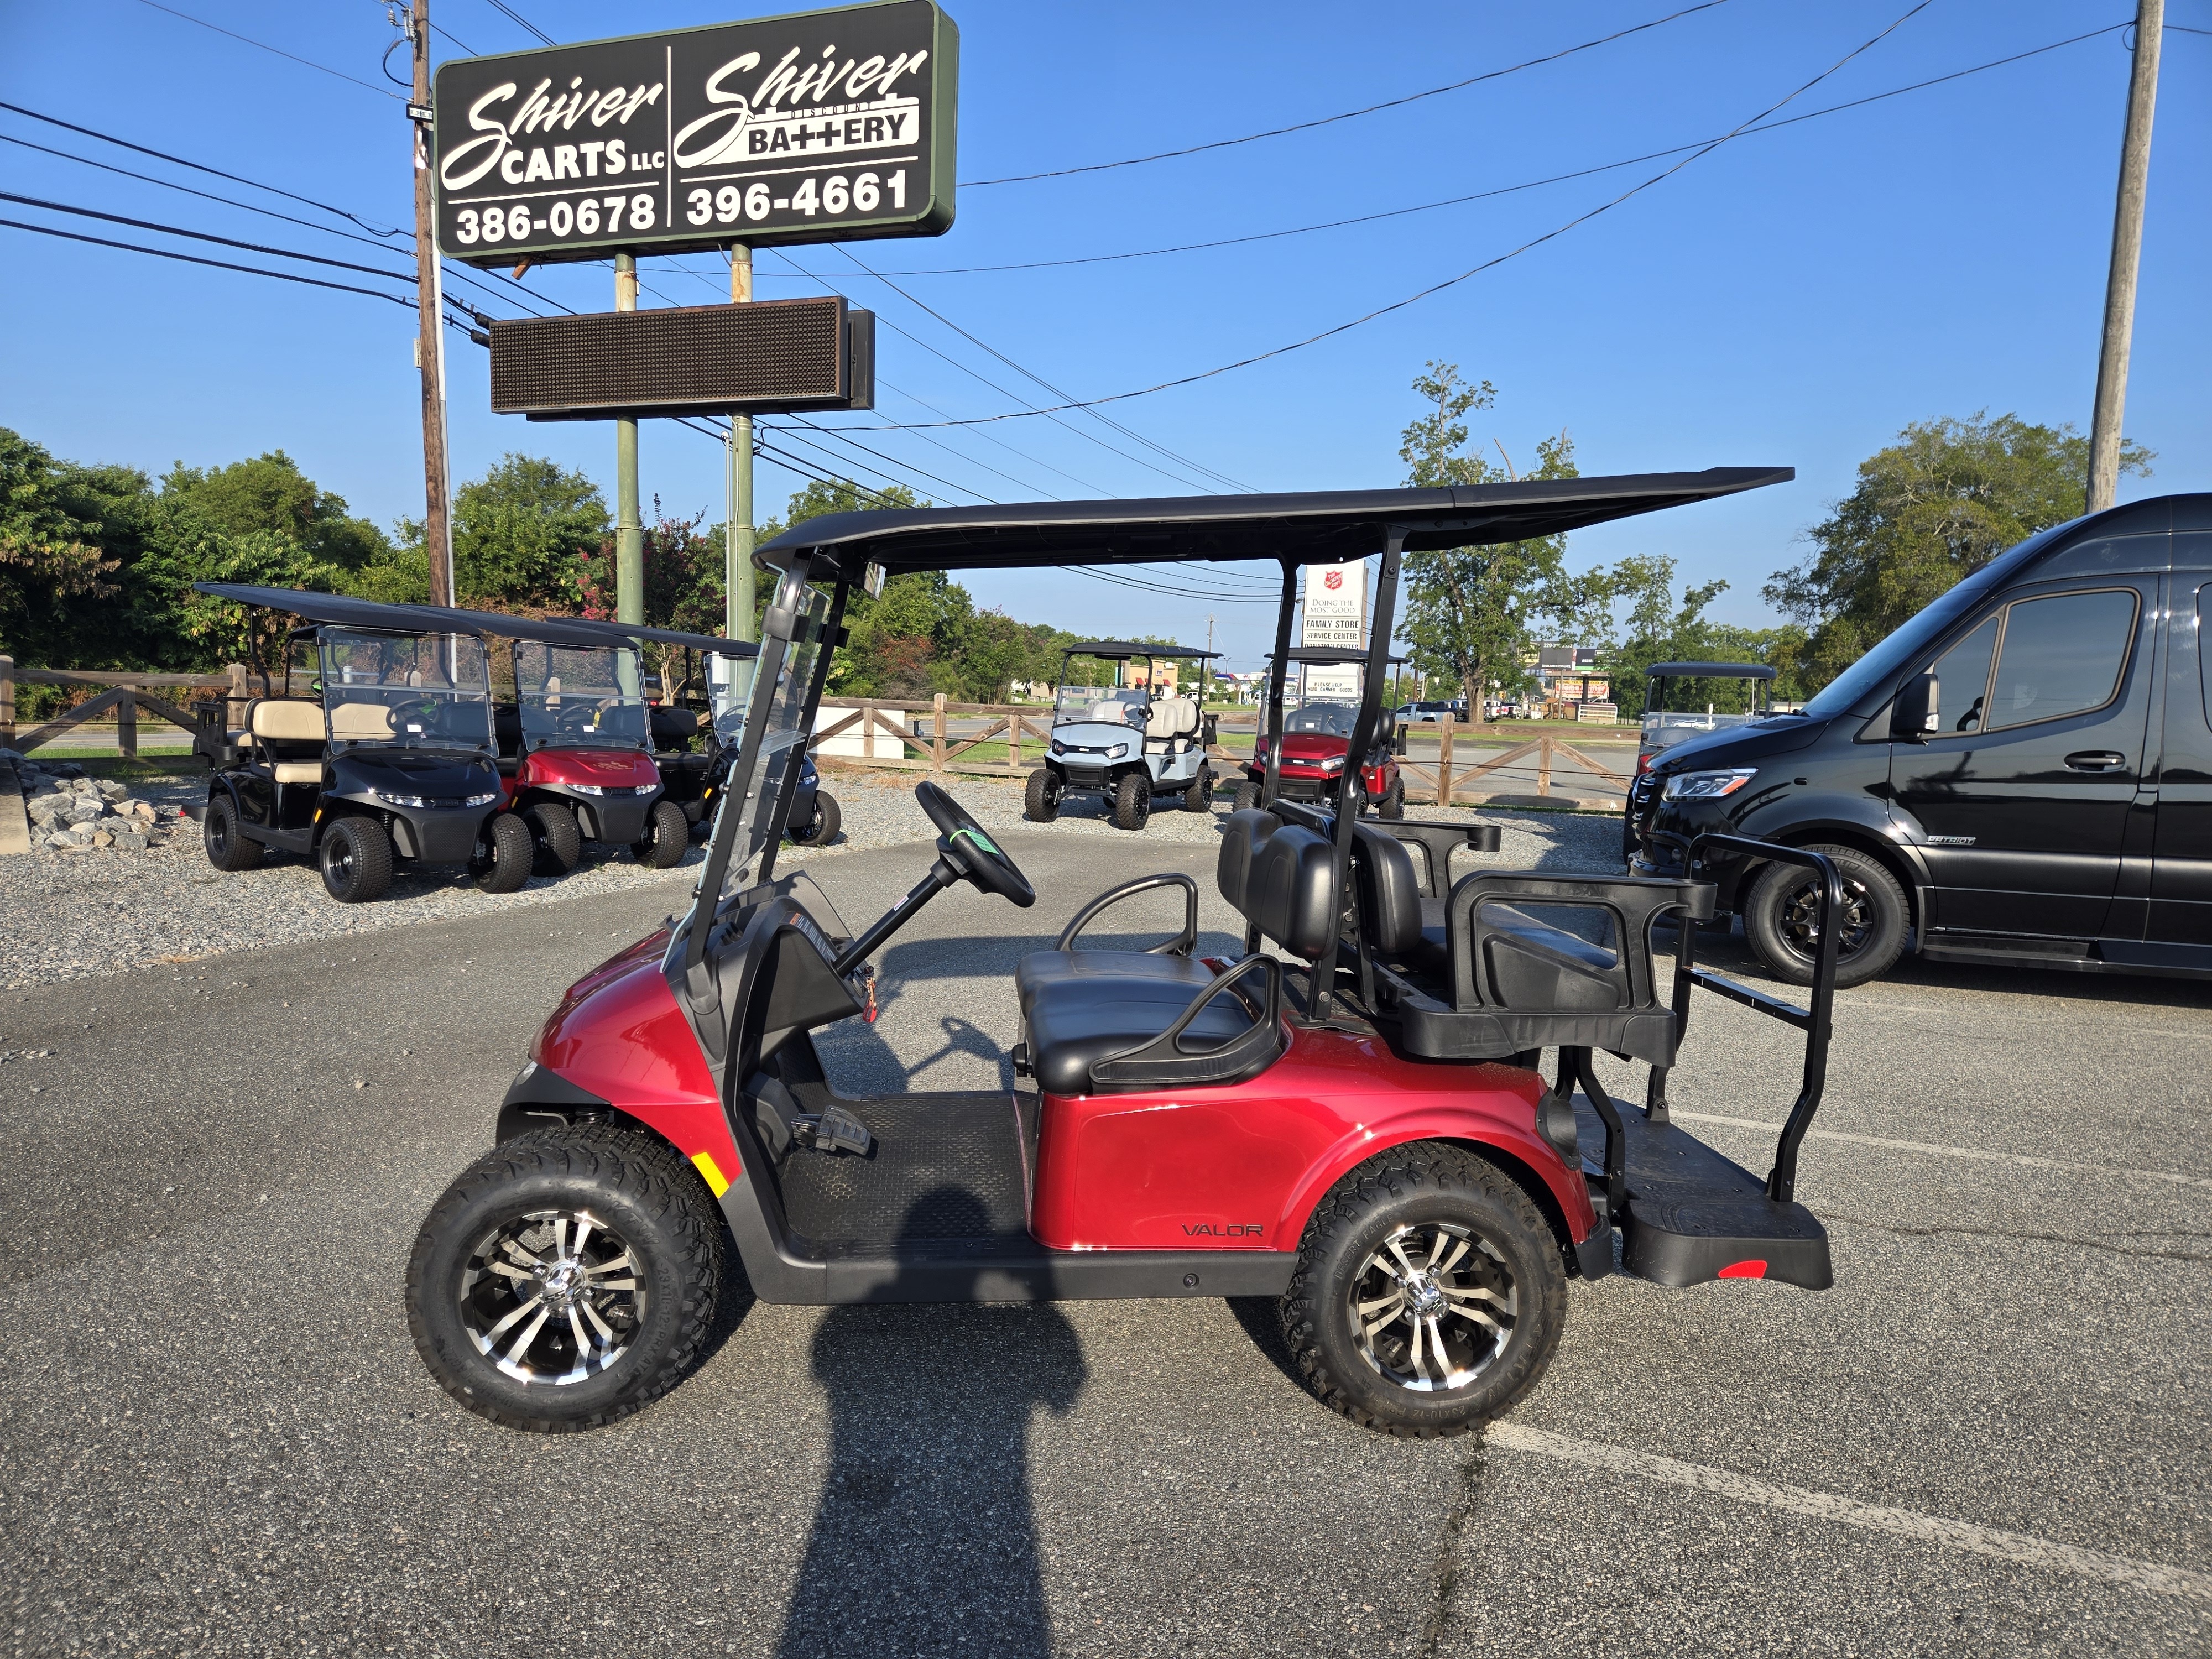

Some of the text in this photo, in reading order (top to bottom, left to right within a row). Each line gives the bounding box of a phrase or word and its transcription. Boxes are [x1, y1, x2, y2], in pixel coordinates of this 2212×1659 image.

[674, 44, 928, 169] Shiver
[791, 102, 872, 118] DISCOUNT
[441, 76, 664, 191] Shiver
[501, 139, 664, 185] CARTS LLC
[456, 194, 655, 245] 386-0678
[687, 169, 905, 226] 396-4661
[1306, 620, 1359, 629] FAMILY STORE
[1928, 836, 1976, 844] PATRIOT
[1181, 1224, 1264, 1237] VALOR
[1334, 1213, 1393, 1280] DESERT EAGLE
